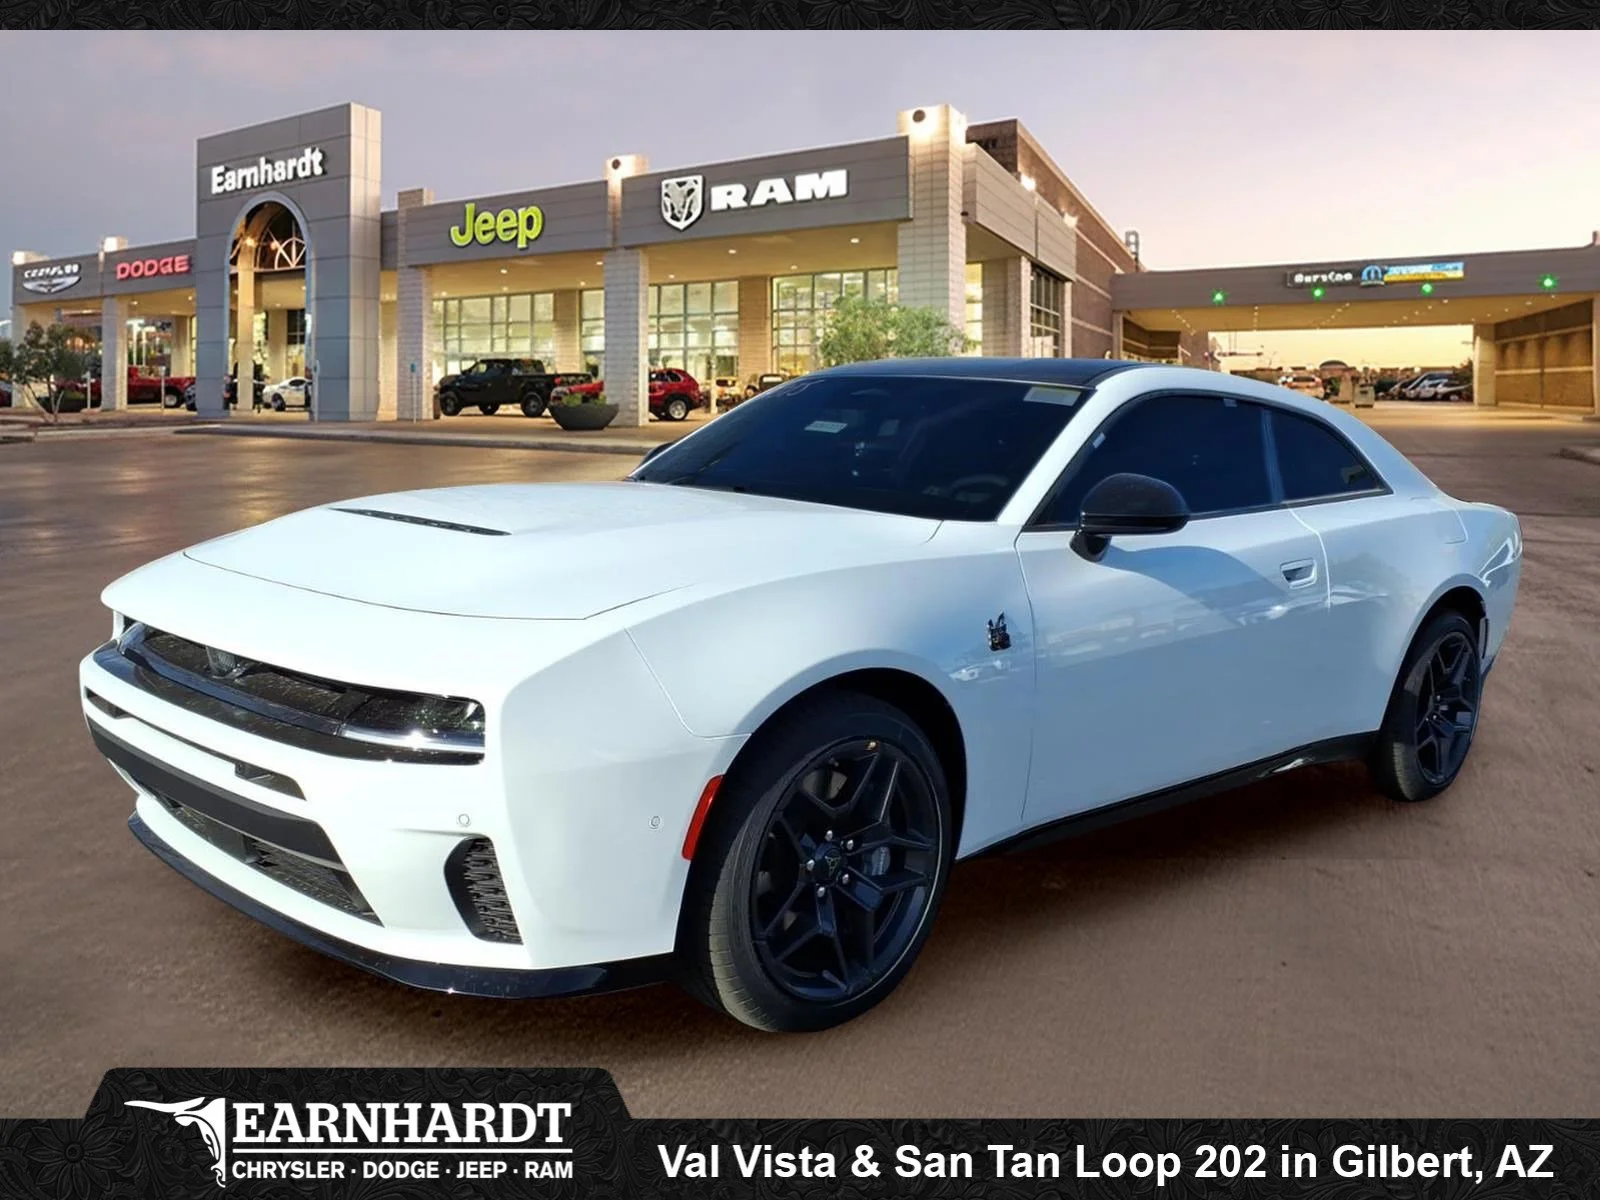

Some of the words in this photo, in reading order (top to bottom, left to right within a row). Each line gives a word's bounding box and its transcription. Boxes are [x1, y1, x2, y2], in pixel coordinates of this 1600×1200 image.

[211, 147, 323, 194] Earnhardt
[710, 169, 847, 211] RAM
[450, 202, 543, 249] Jeep
[116, 255, 190, 280] DODGE
